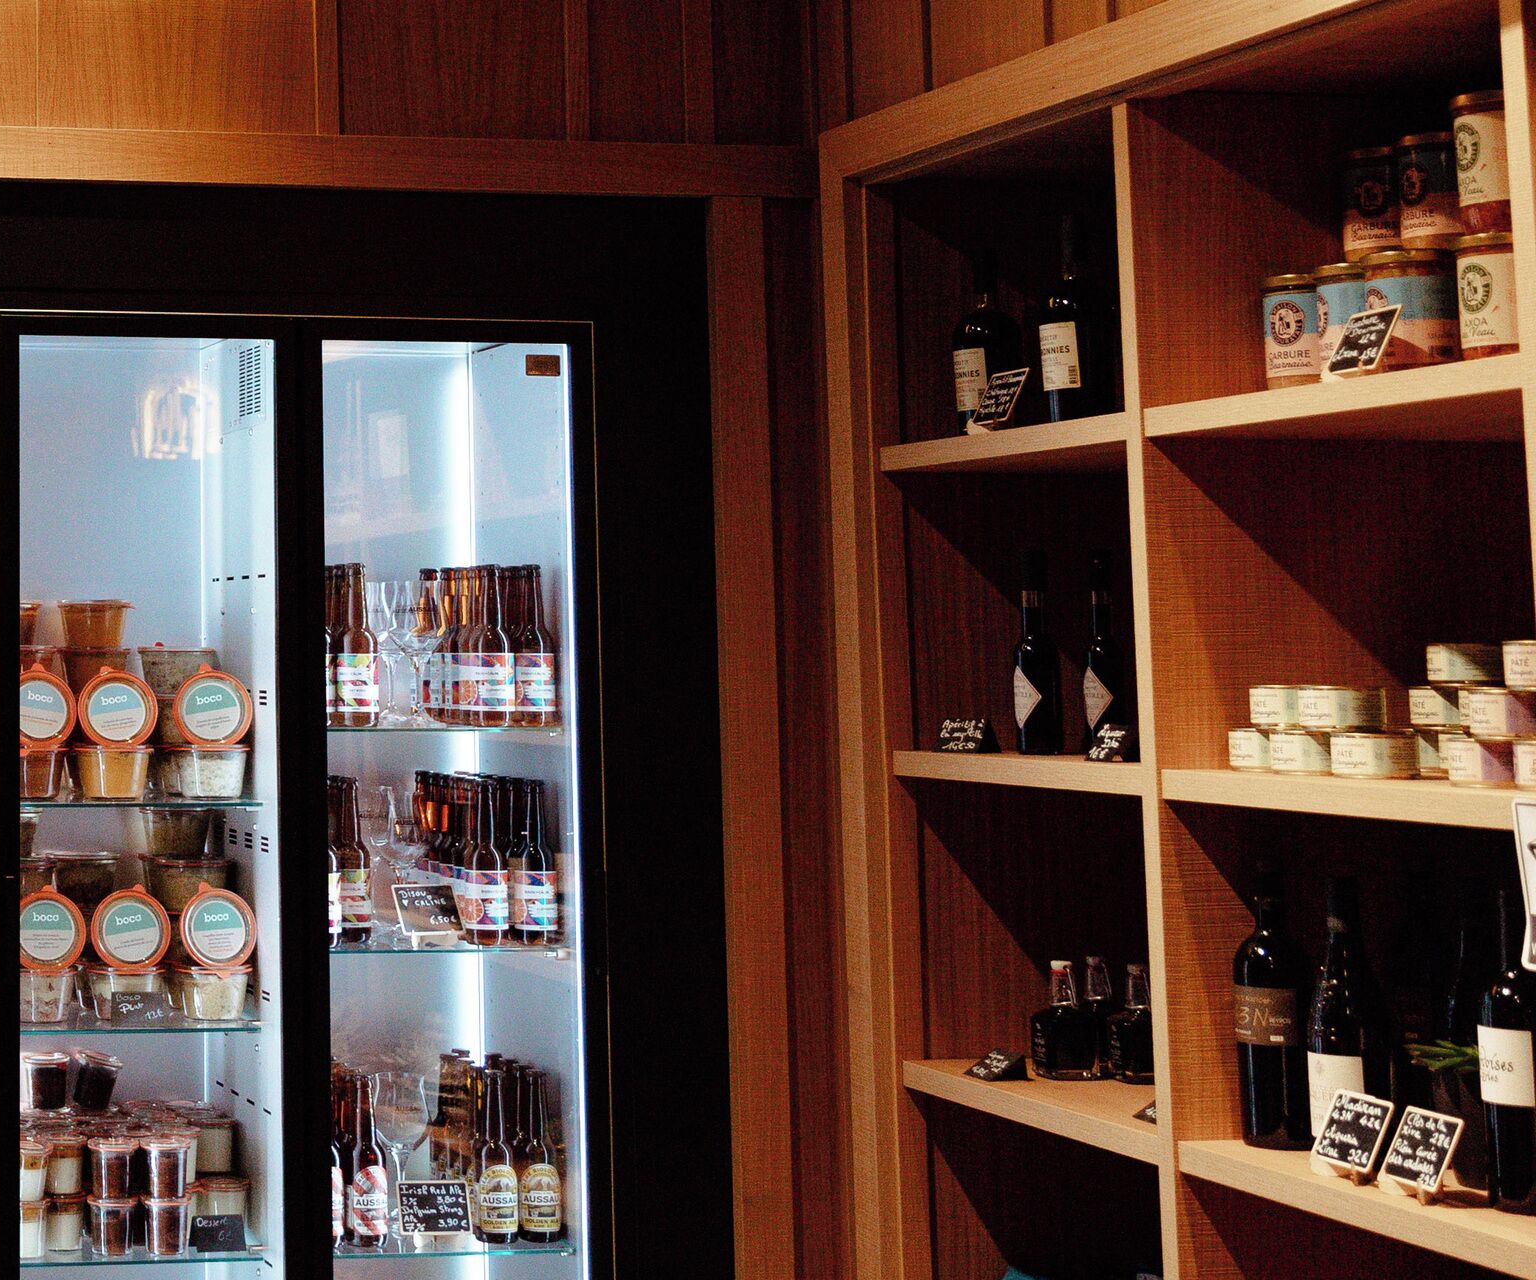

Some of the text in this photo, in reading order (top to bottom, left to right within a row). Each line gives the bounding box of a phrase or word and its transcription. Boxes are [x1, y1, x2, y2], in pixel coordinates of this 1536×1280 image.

[27, 690, 54, 704] boco
[100, 694, 127, 706] boco
[195, 693, 222, 706] boco
[32, 912, 59, 923] boco
[115, 913, 143, 926] boco
[203, 912, 229, 923] boco
[429, 1185, 447, 1196] Red
